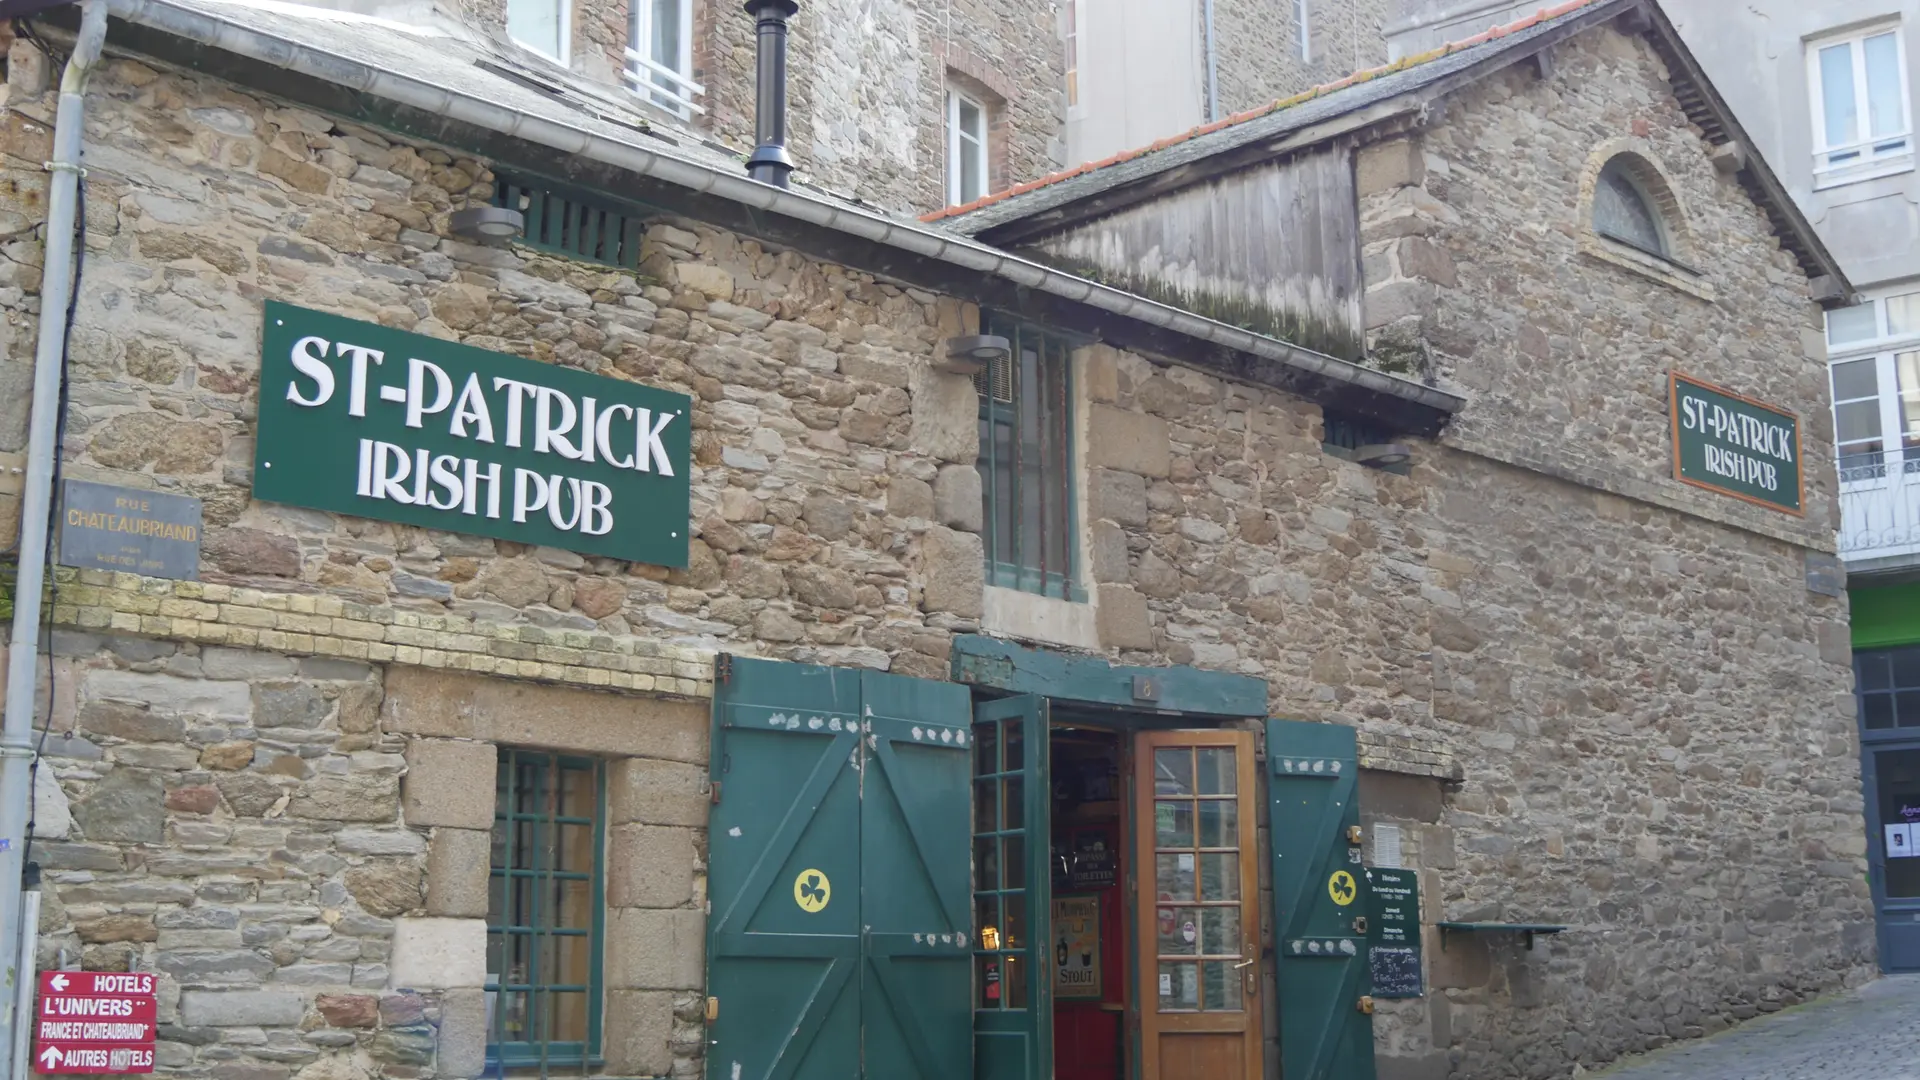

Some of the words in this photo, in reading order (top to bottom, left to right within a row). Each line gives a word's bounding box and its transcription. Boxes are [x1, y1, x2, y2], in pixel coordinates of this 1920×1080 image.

[286, 335, 674, 477] ST-PATRICK
[1682, 396, 1792, 462] ST-PATRICK
[1704, 444, 1747, 482] IRISH
[1747, 457, 1777, 491] PUB
[356, 438, 502, 519] IRISH
[511, 467, 613, 536] PUB
[115, 497, 150, 512] RUE
[68, 509, 197, 542] CHATEAUBRIAND
[1143, 679, 1151, 697] 8
[94, 975, 151, 993] HOTELS
[45, 998, 133, 1016] L'UNIVERS
[41, 1022, 72, 1040] FRANCE
[72, 1023, 83, 1040] ET
[64, 1050, 107, 1067] AUTRES
[109, 1050, 153, 1067] HOTELS
